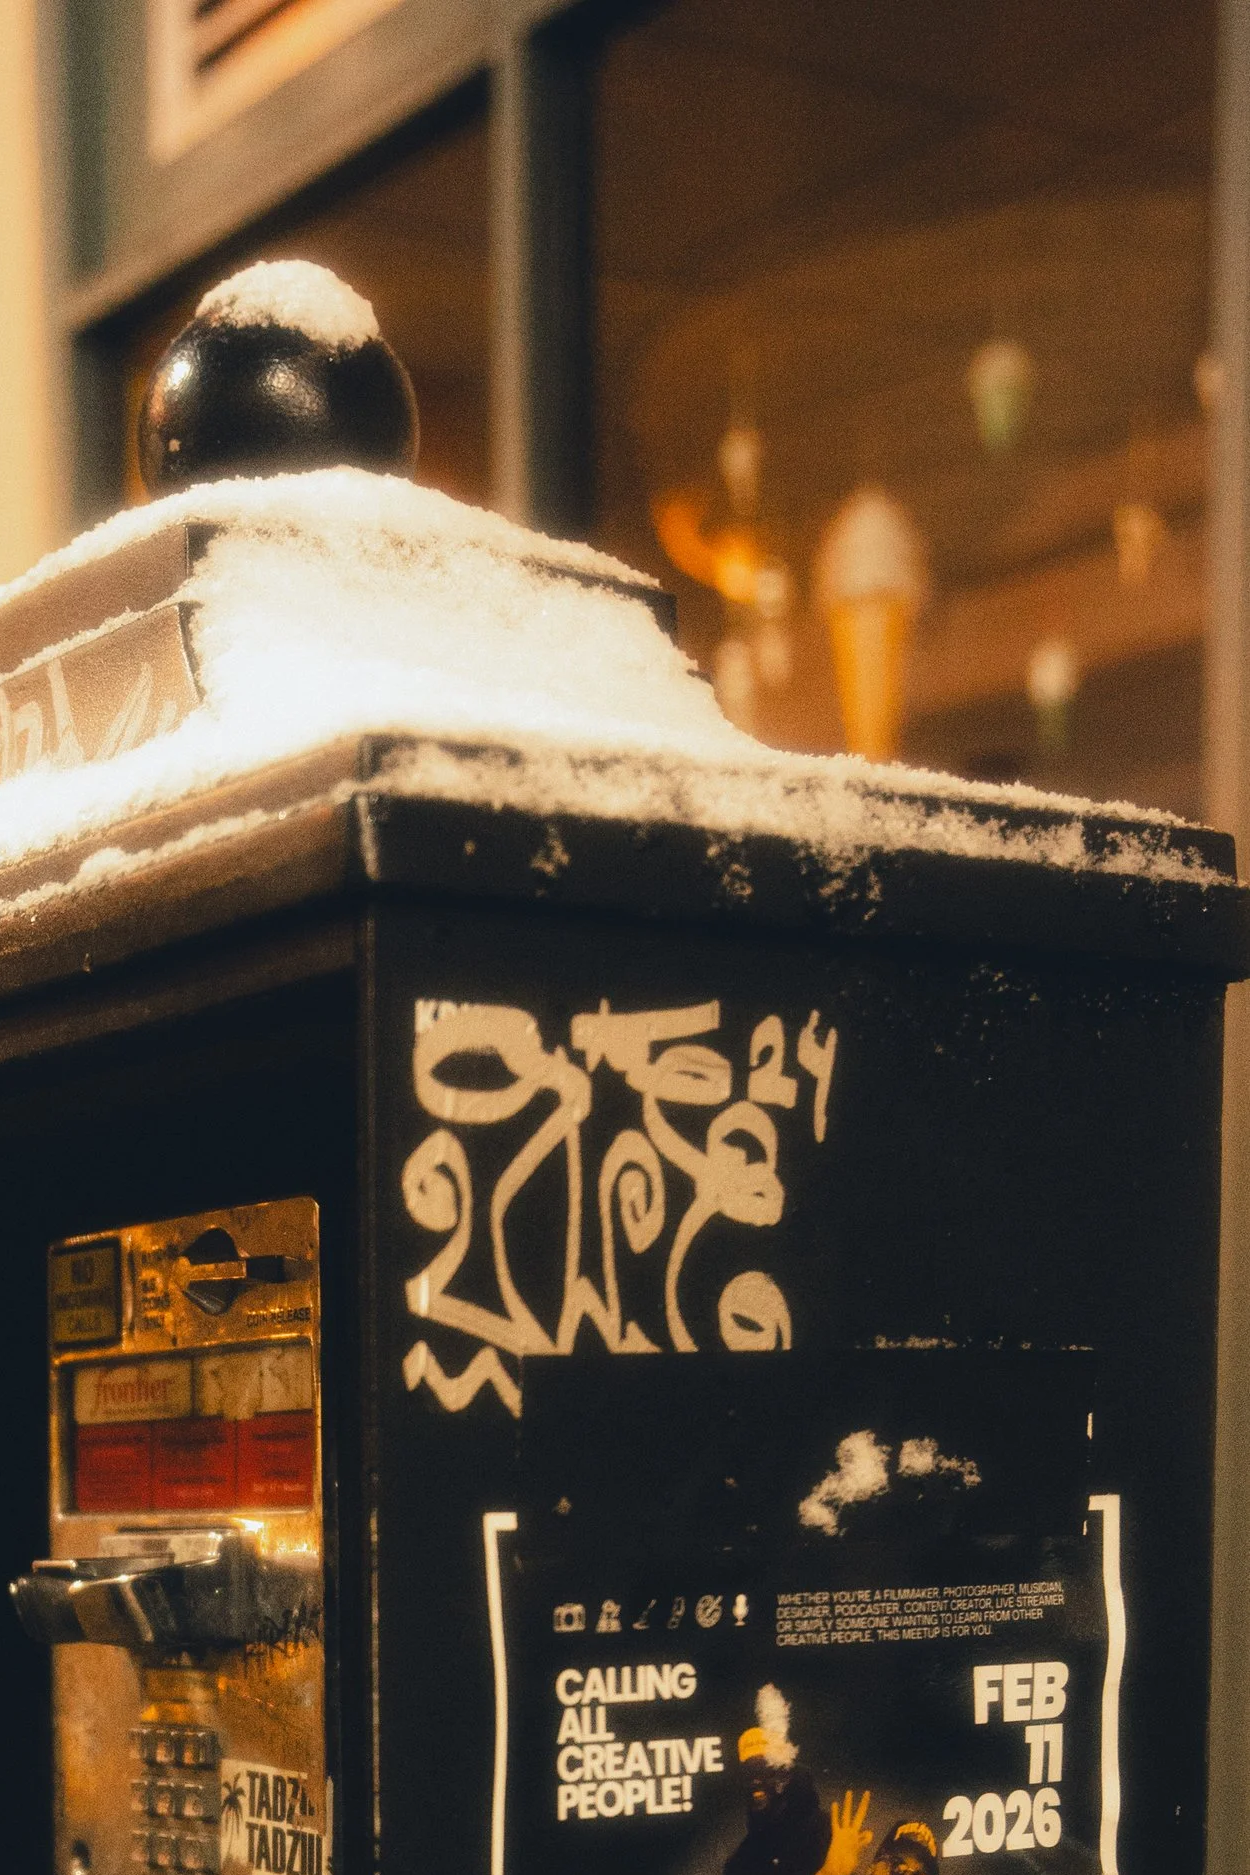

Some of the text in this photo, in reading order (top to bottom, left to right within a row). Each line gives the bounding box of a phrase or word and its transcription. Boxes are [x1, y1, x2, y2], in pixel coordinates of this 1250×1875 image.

[777, 1592, 830, 1605] WHETHER
[833, 1589, 871, 1602] YOU'RE
[873, 1589, 882, 1600] A
[943, 1583, 1017, 1598] PHOTOGRAPHER,
[1019, 1581, 1064, 1594] MUSICIAN,
[904, 1600, 948, 1613] CONTENT
[950, 1598, 993, 1611] CREATOR,
[996, 1597, 1014, 1609] LIVE
[1016, 1594, 1065, 1607] STREAMER
[776, 1608, 1044, 1633] OR SIMPLY SOMEONE WANTING TO LEARN FROM OTHER
[776, 1632, 829, 1646] CREATIVE
[877, 1629, 900, 1641] THIS
[902, 1626, 940, 1640] MEETUP
[942, 1626, 950, 1637] IS
[952, 1625, 971, 1637] FOR
[972, 1623, 993, 1636] YOU.
[555, 1662, 697, 1706] CALLING
[973, 1661, 1069, 1725] FEB
[557, 1705, 616, 1745] ALL
[556, 1736, 724, 1782] CREATIVE
[1025, 1723, 1063, 1784] 11
[246, 1769, 316, 1825] TADZI
[557, 1774, 693, 1822] PEOPLE!
[941, 1787, 1062, 1859] 2026
